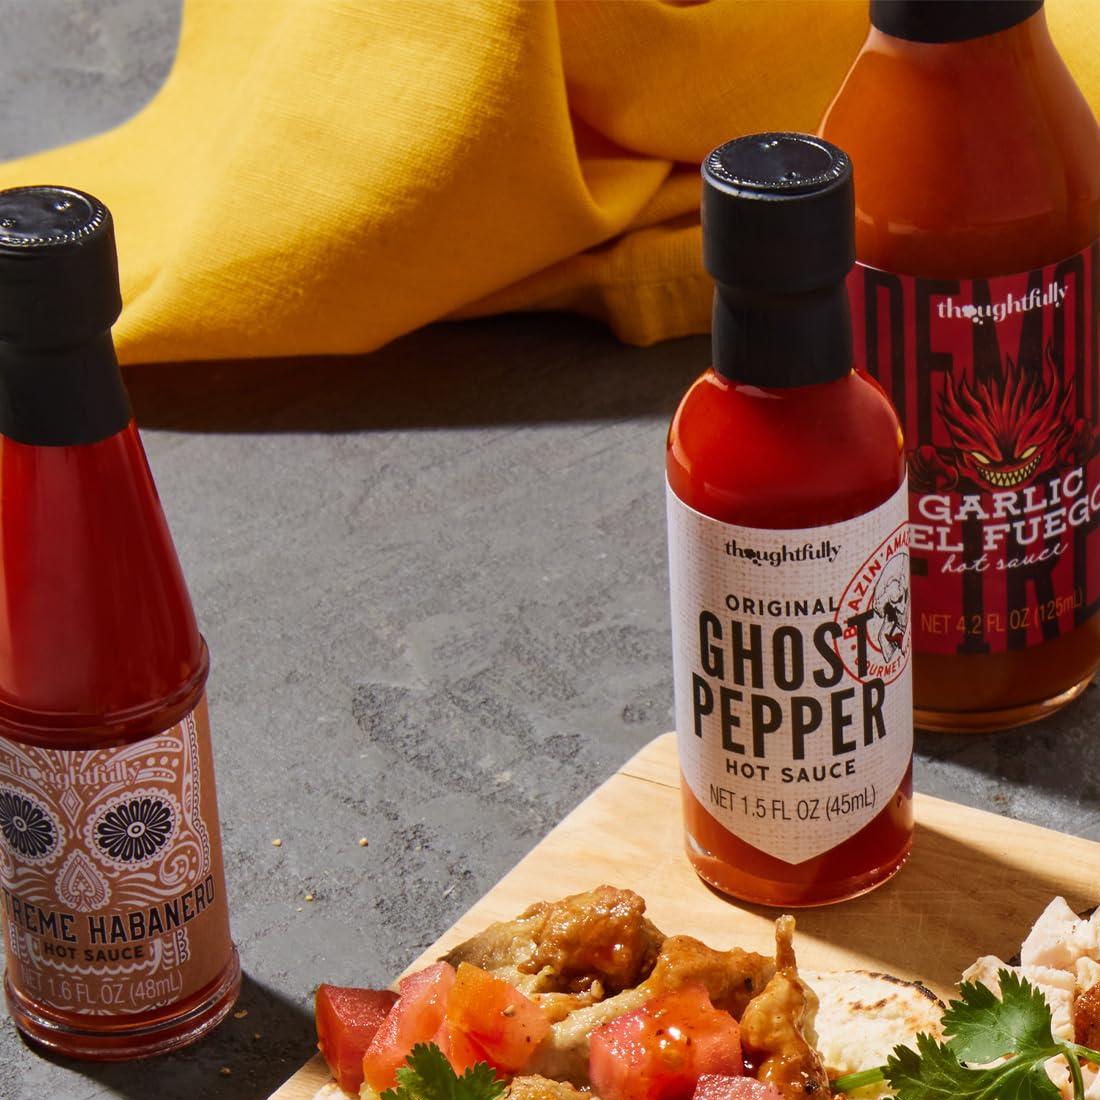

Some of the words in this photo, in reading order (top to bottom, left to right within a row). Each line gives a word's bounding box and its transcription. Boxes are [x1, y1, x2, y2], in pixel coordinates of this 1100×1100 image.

[937, 281, 1068, 325] thoughtfully
[918, 467, 1083, 524] GARLIC
[725, 540, 842, 567] thoughtfully
[908, 523, 964, 551] EL
[941, 553, 990, 574] hot
[995, 542, 1069, 571] sauce
[726, 594, 839, 617] ORIGINAL
[920, 613, 951, 634] NET
[956, 614, 982, 635] 4.2
[987, 613, 1005, 632] FL
[1009, 608, 1030, 630] OZ
[700, 609, 875, 692] GHOST
[692, 672, 887, 760] PEPPER
[726, 758, 769, 781] HOT
[781, 759, 856, 783] SAUCE
[710, 783, 736, 809] NET
[742, 793, 766, 818] 1.5
[772, 799, 791, 820] FL
[797, 799, 820, 820] OZ
[826, 785, 876, 822] (45mL)
[89, 874, 216, 945] HABANERO
[44, 943, 76, 961] HOT
[84, 945, 144, 961] SAUCE
[49, 976, 72, 1000] 1.6
[76, 983, 93, 1002] FL
[100, 984, 124, 1005] OZ
[130, 970, 183, 1001] (48mL)
